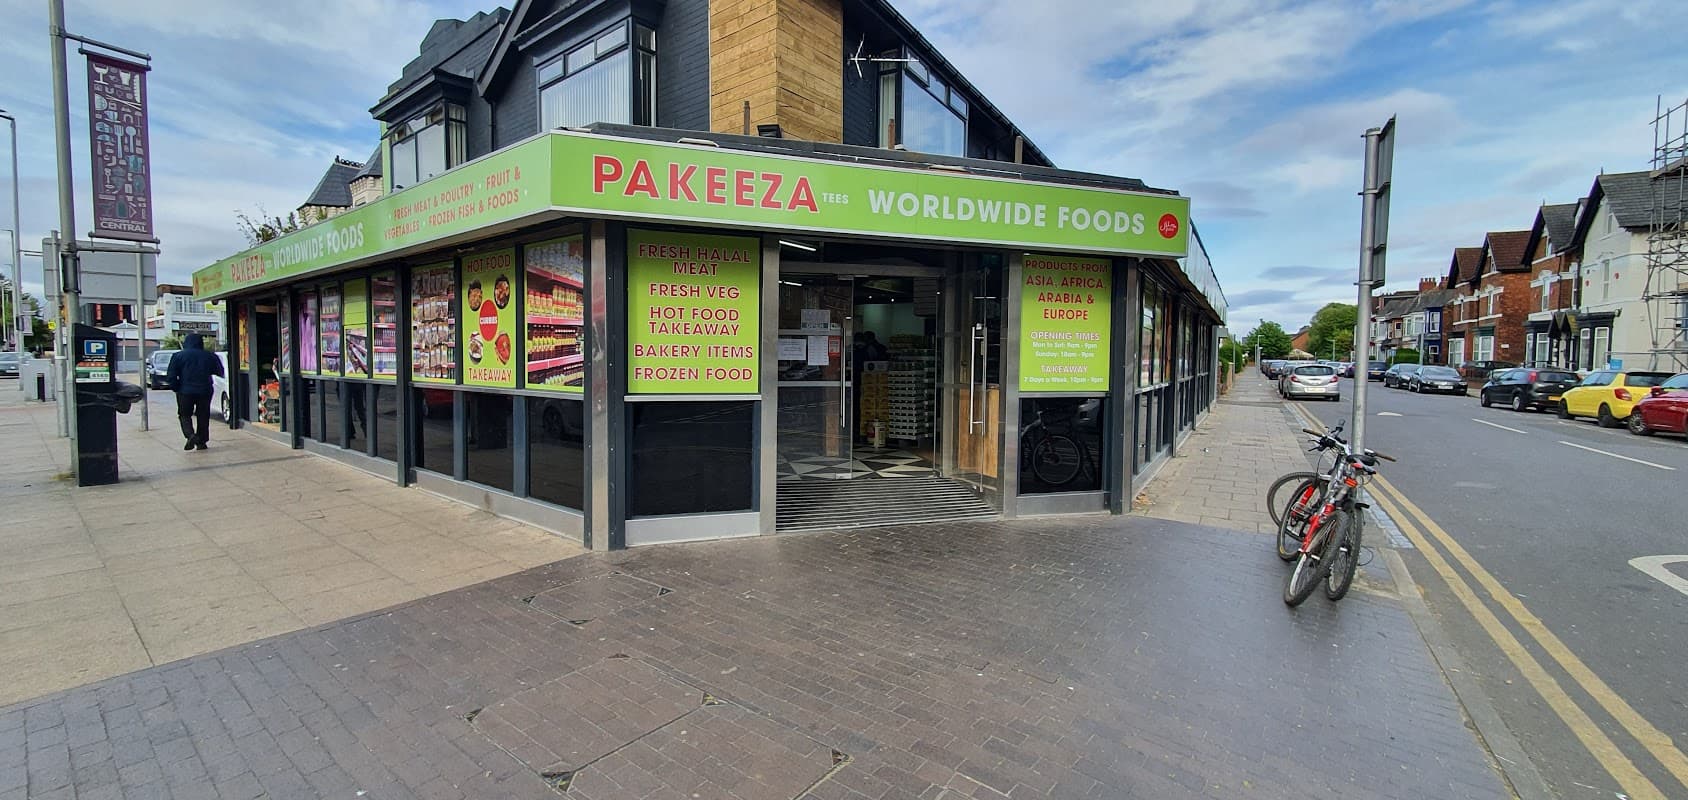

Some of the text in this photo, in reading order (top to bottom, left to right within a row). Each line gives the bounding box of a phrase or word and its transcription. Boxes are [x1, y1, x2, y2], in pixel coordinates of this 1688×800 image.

[592, 154, 820, 214] PAKEEZA
[394, 204, 412, 221] FRESH
[414, 198, 431, 214] MEAT
[440, 182, 475, 205] POULTRY
[486, 169, 511, 191] FRUIT
[514, 166, 521, 181] &
[822, 192, 849, 205] TEES
[428, 208, 456, 227] FROZEN
[458, 202, 475, 219] FISH
[478, 199, 485, 213] &
[487, 188, 520, 210] FOODS
[868, 189, 1046, 227] WORLDWIDE
[1058, 206, 1145, 235] FOODS
[101, 221, 148, 233] CENTRAL
[272, 222, 364, 270] WORLDWIDE FOODS
[639, 244, 751, 263] FRESH HALAL
[231, 254, 267, 283] PAKEEZA
[467, 254, 511, 273] HOT FOOD
[673, 261, 718, 276] MEAT
[1025, 260, 1108, 273] PRODUCTS FROM
[1026, 274, 1058, 288] ASIA,
[649, 283, 740, 299] FRESH VEG
[1038, 292, 1095, 304] ARABIA &
[649, 306, 740, 321] HOT FOOD
[1043, 308, 1089, 320] EUROPE
[648, 321, 740, 336] TAKEAWAY
[1030, 331, 1100, 341] OPENING TIMES
[90, 342, 104, 353] P
[633, 344, 753, 359] BAKERY ITEMS
[468, 367, 512, 382] TAKEAWAY
[634, 367, 753, 381] FROZEN FOOD
[1041, 365, 1088, 374] TAKEAWAY
